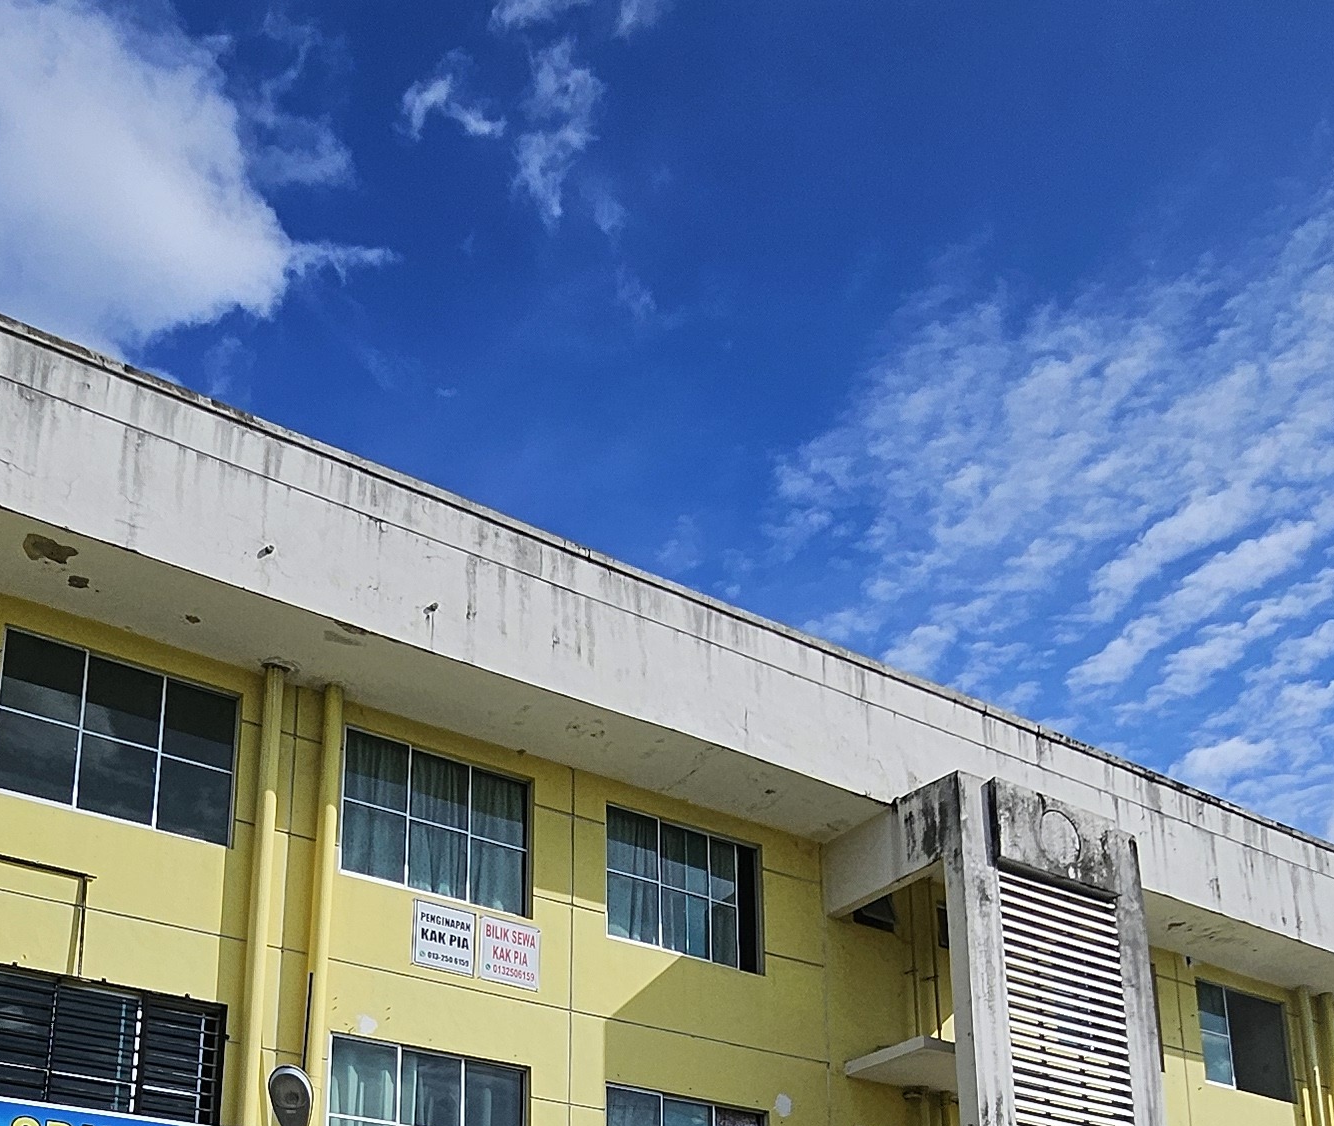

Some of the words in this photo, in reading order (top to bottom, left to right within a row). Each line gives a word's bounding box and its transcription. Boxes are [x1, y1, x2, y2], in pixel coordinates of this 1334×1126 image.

[420, 912, 471, 932] PENGINAPAN
[421, 928, 446, 945] KAK
[449, 935, 469, 950] PIA
[486, 924, 509, 943] BILIK
[511, 930, 536, 949] SEWA
[492, 945, 512, 963] KAK
[513, 951, 528, 967] PIA
[492, 964, 535, 982] 0132506159
